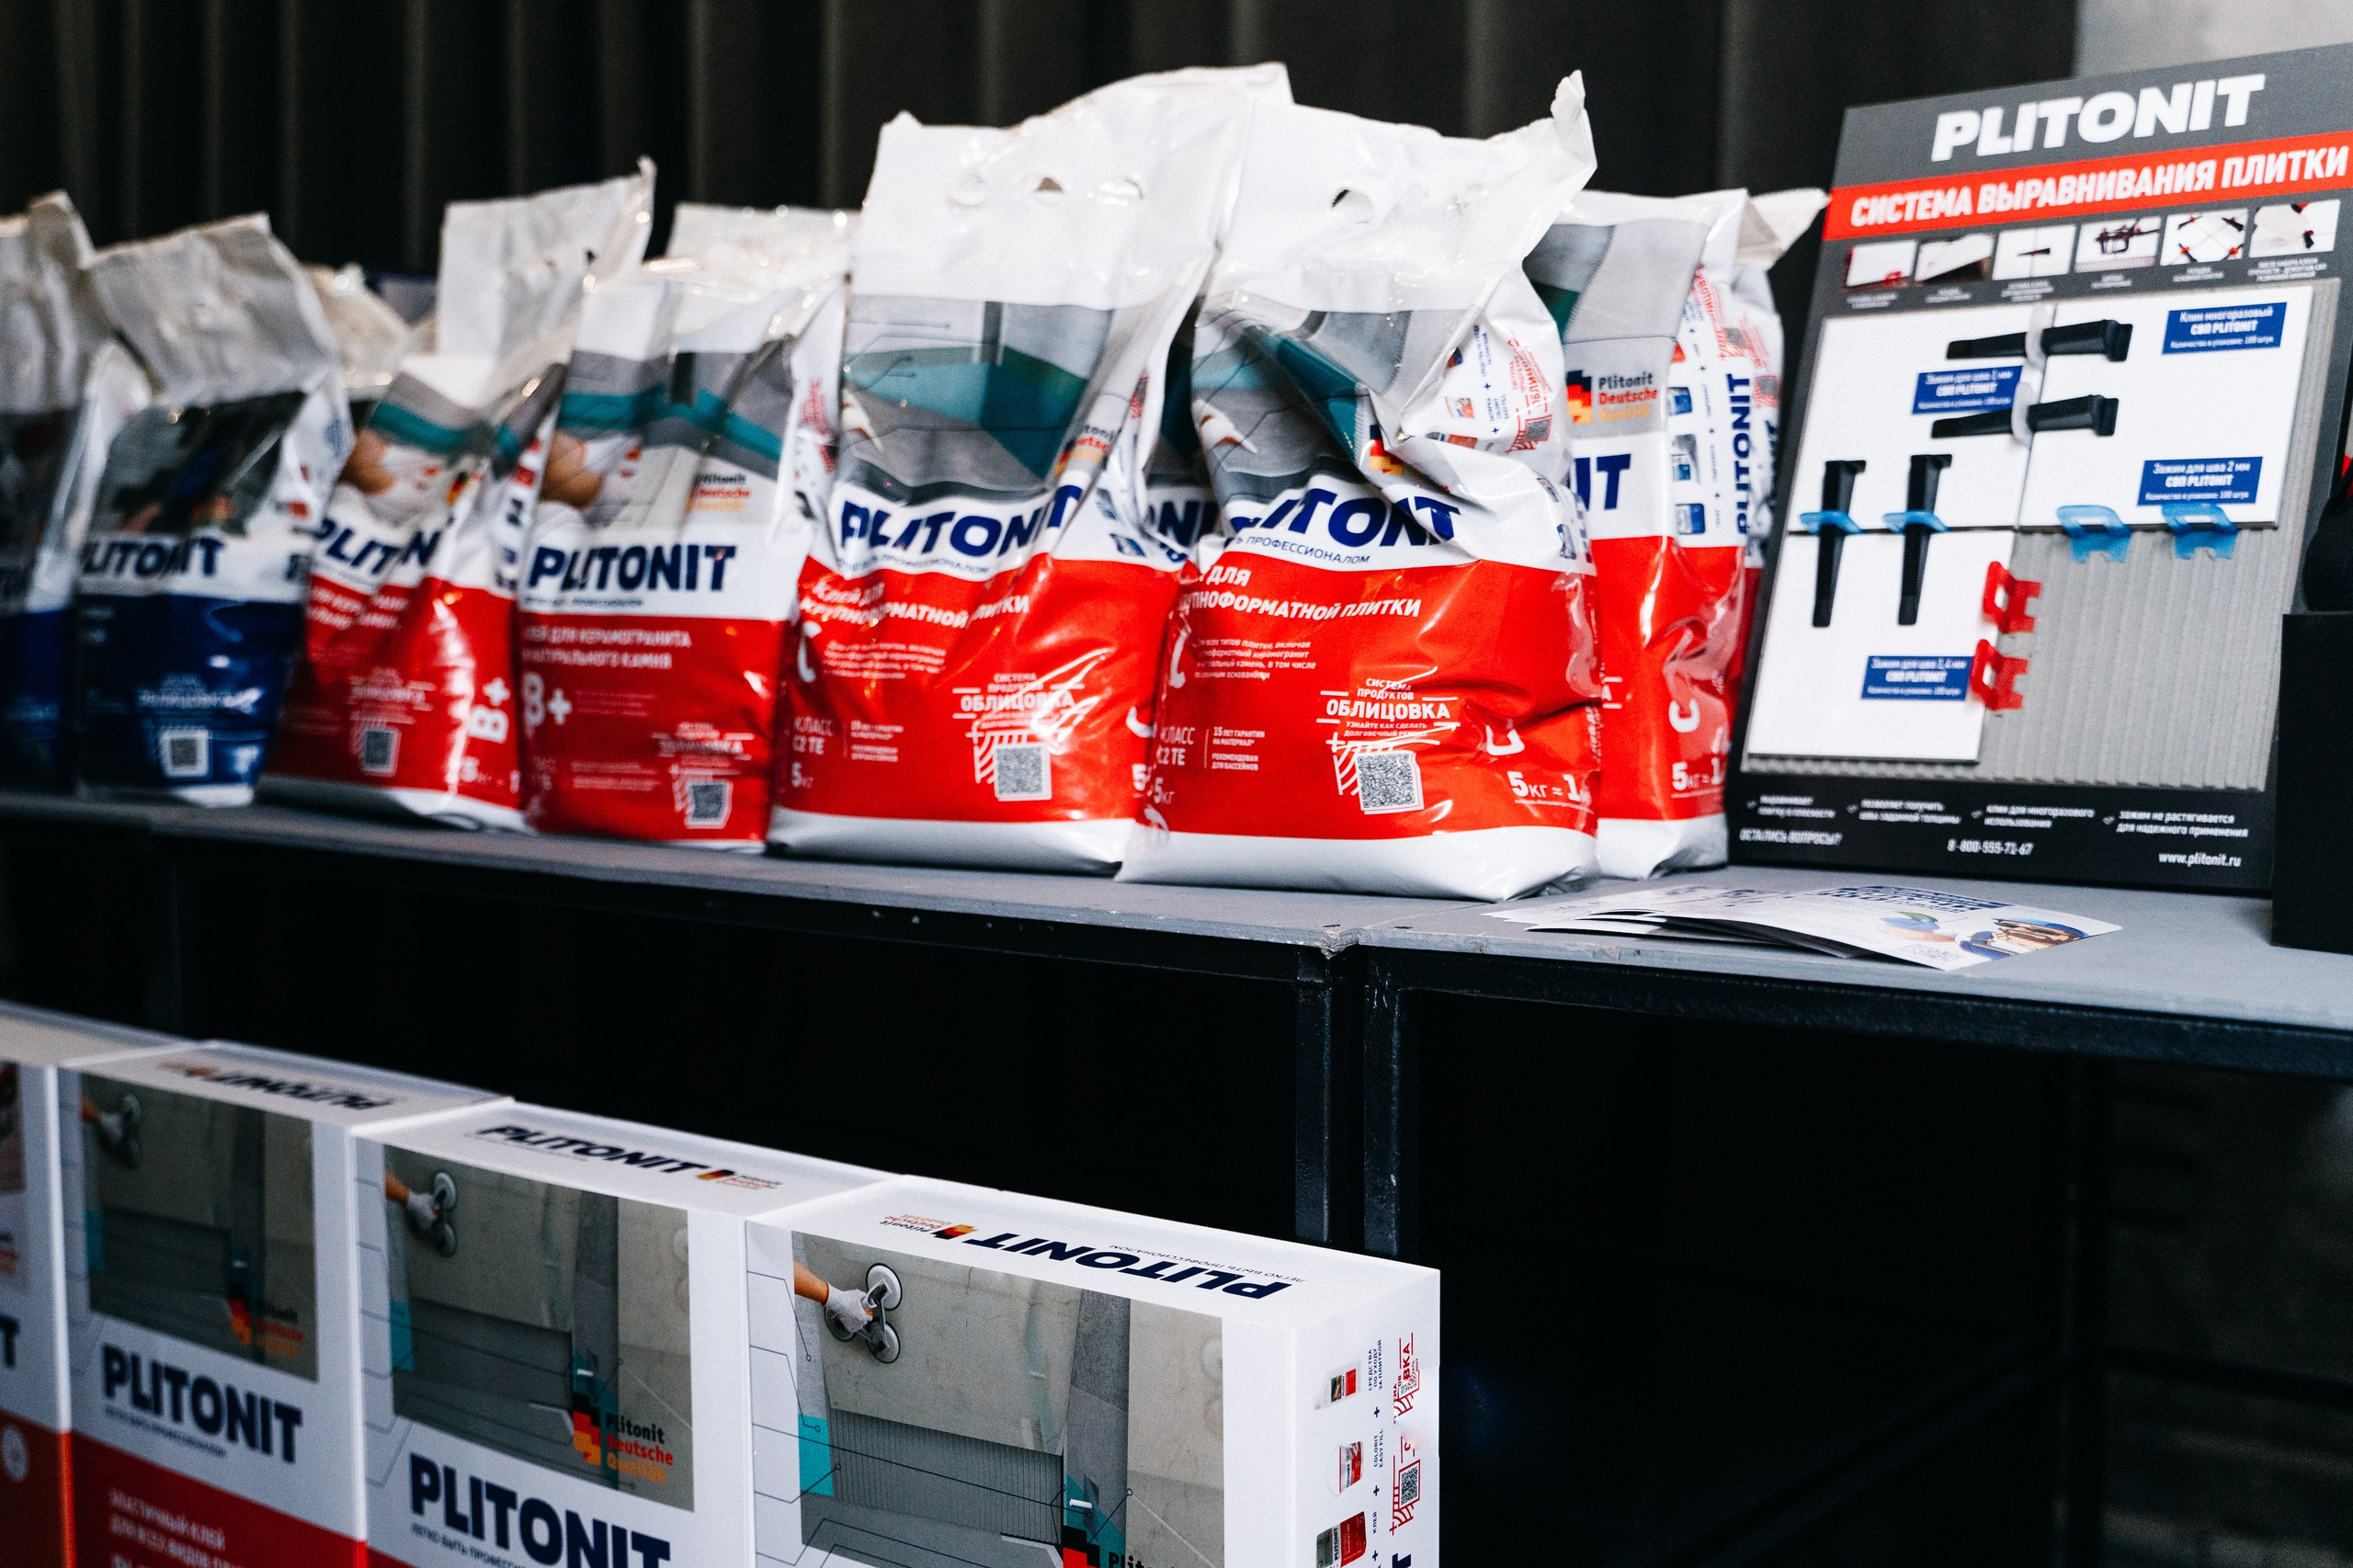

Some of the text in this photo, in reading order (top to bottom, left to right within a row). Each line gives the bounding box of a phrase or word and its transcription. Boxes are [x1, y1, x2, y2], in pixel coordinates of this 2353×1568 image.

[1931, 74, 2266, 162] PLITONIT
[1850, 145, 2349, 227] СИСТЕМА ВЫРАВНИВАНИЯ ПЛИТКИ
[1245, 536, 1370, 565] ПРОФЕССИОНАЛОМ
[1207, 565, 1252, 586] ДЛЯ
[1340, 598, 1422, 619] ПЛИТКИ
[1357, 687, 1415, 700] ПРОДУКТОВ
[1326, 699, 1451, 722] ОБЛИЦОВКА
[2159, 851, 2242, 868] www.plitonit.ru
[475, 1125, 711, 1174] PLITONIT
[961, 1233, 1293, 1301] PLITONIT
[1108, 1244, 1225, 1270] ПРОФЕССИОНАЛОМ
[103, 1343, 304, 1465] PLITONIT
[607, 1431, 674, 1466] Deutsche
[409, 1452, 671, 1568] PLITONIT
